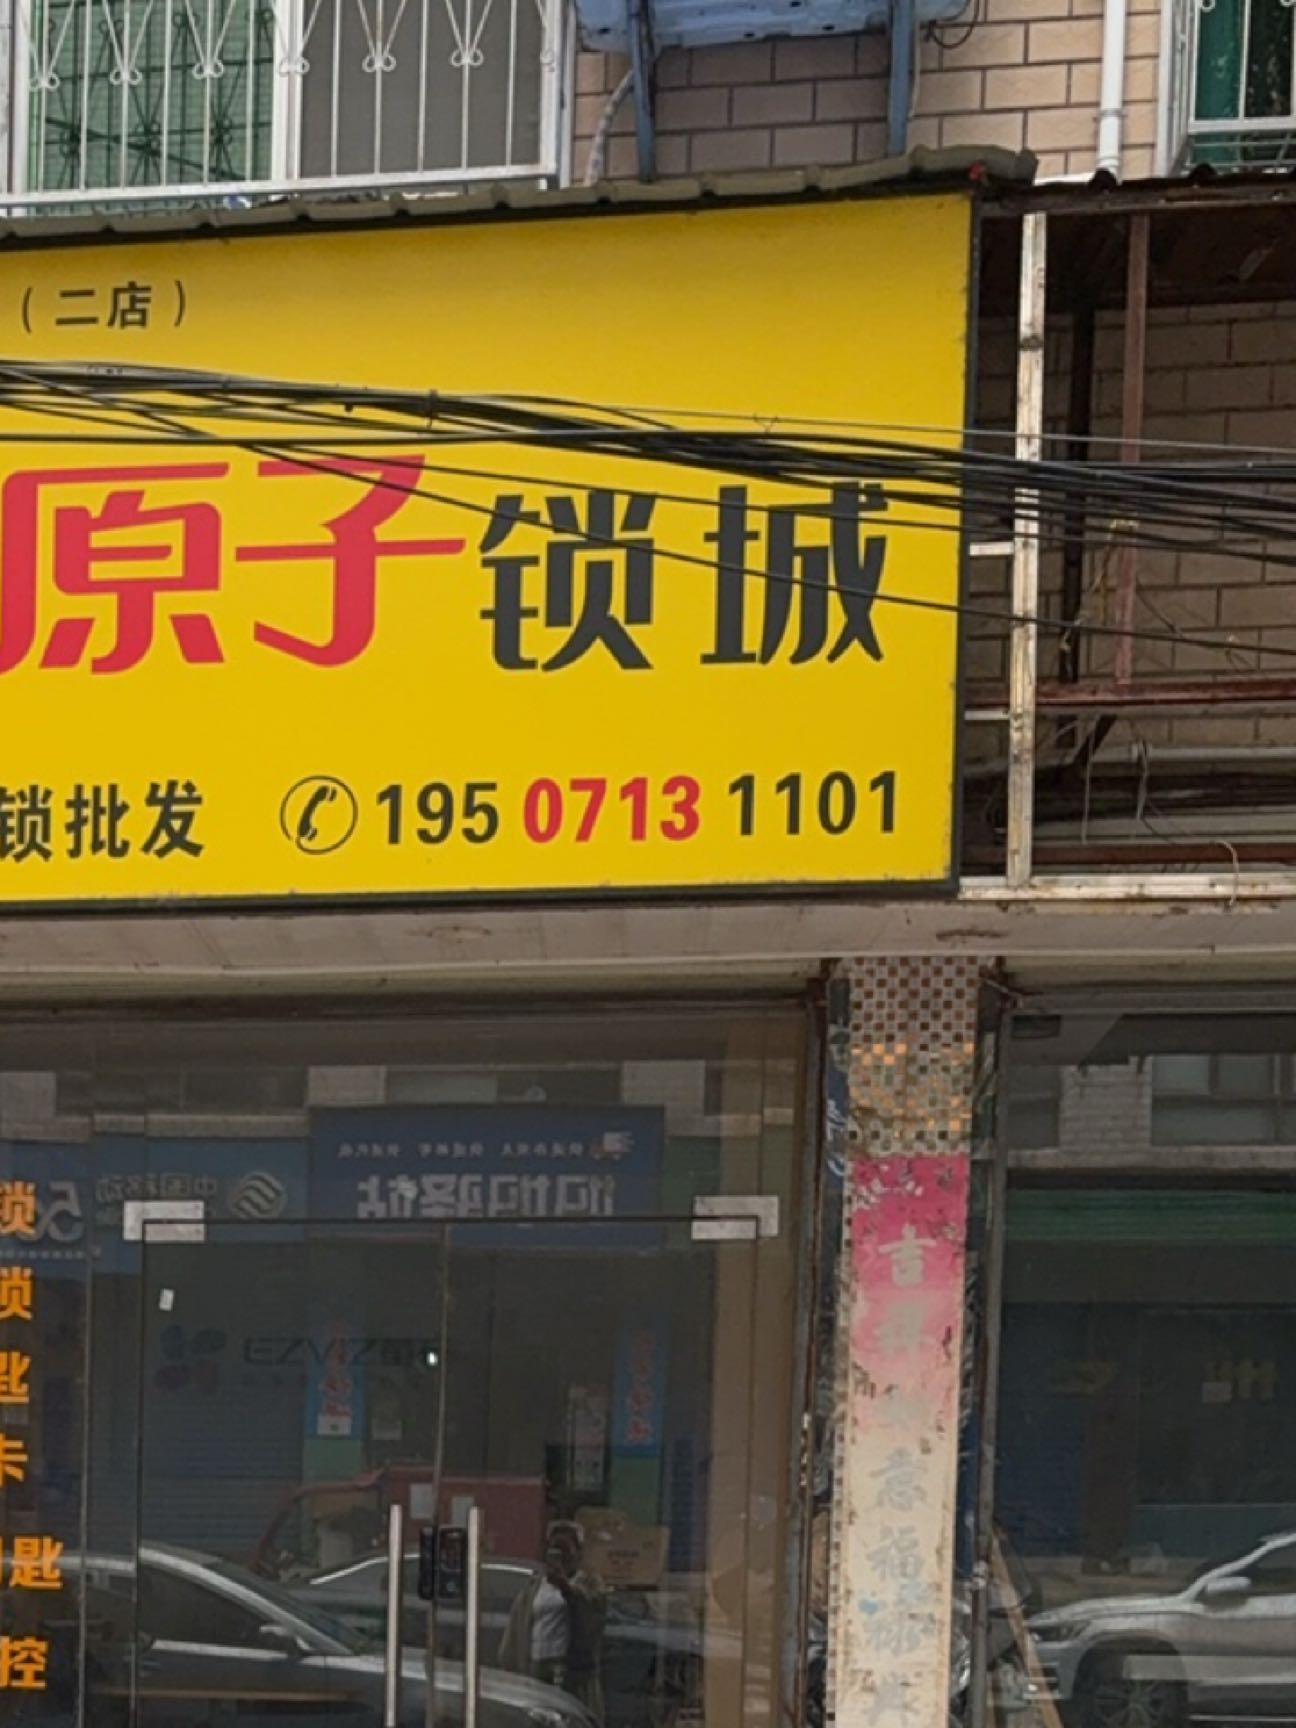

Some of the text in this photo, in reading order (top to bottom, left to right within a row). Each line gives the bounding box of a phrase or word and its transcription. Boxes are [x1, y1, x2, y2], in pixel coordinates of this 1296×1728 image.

[376, 770, 898, 844] 195 0713 1101
